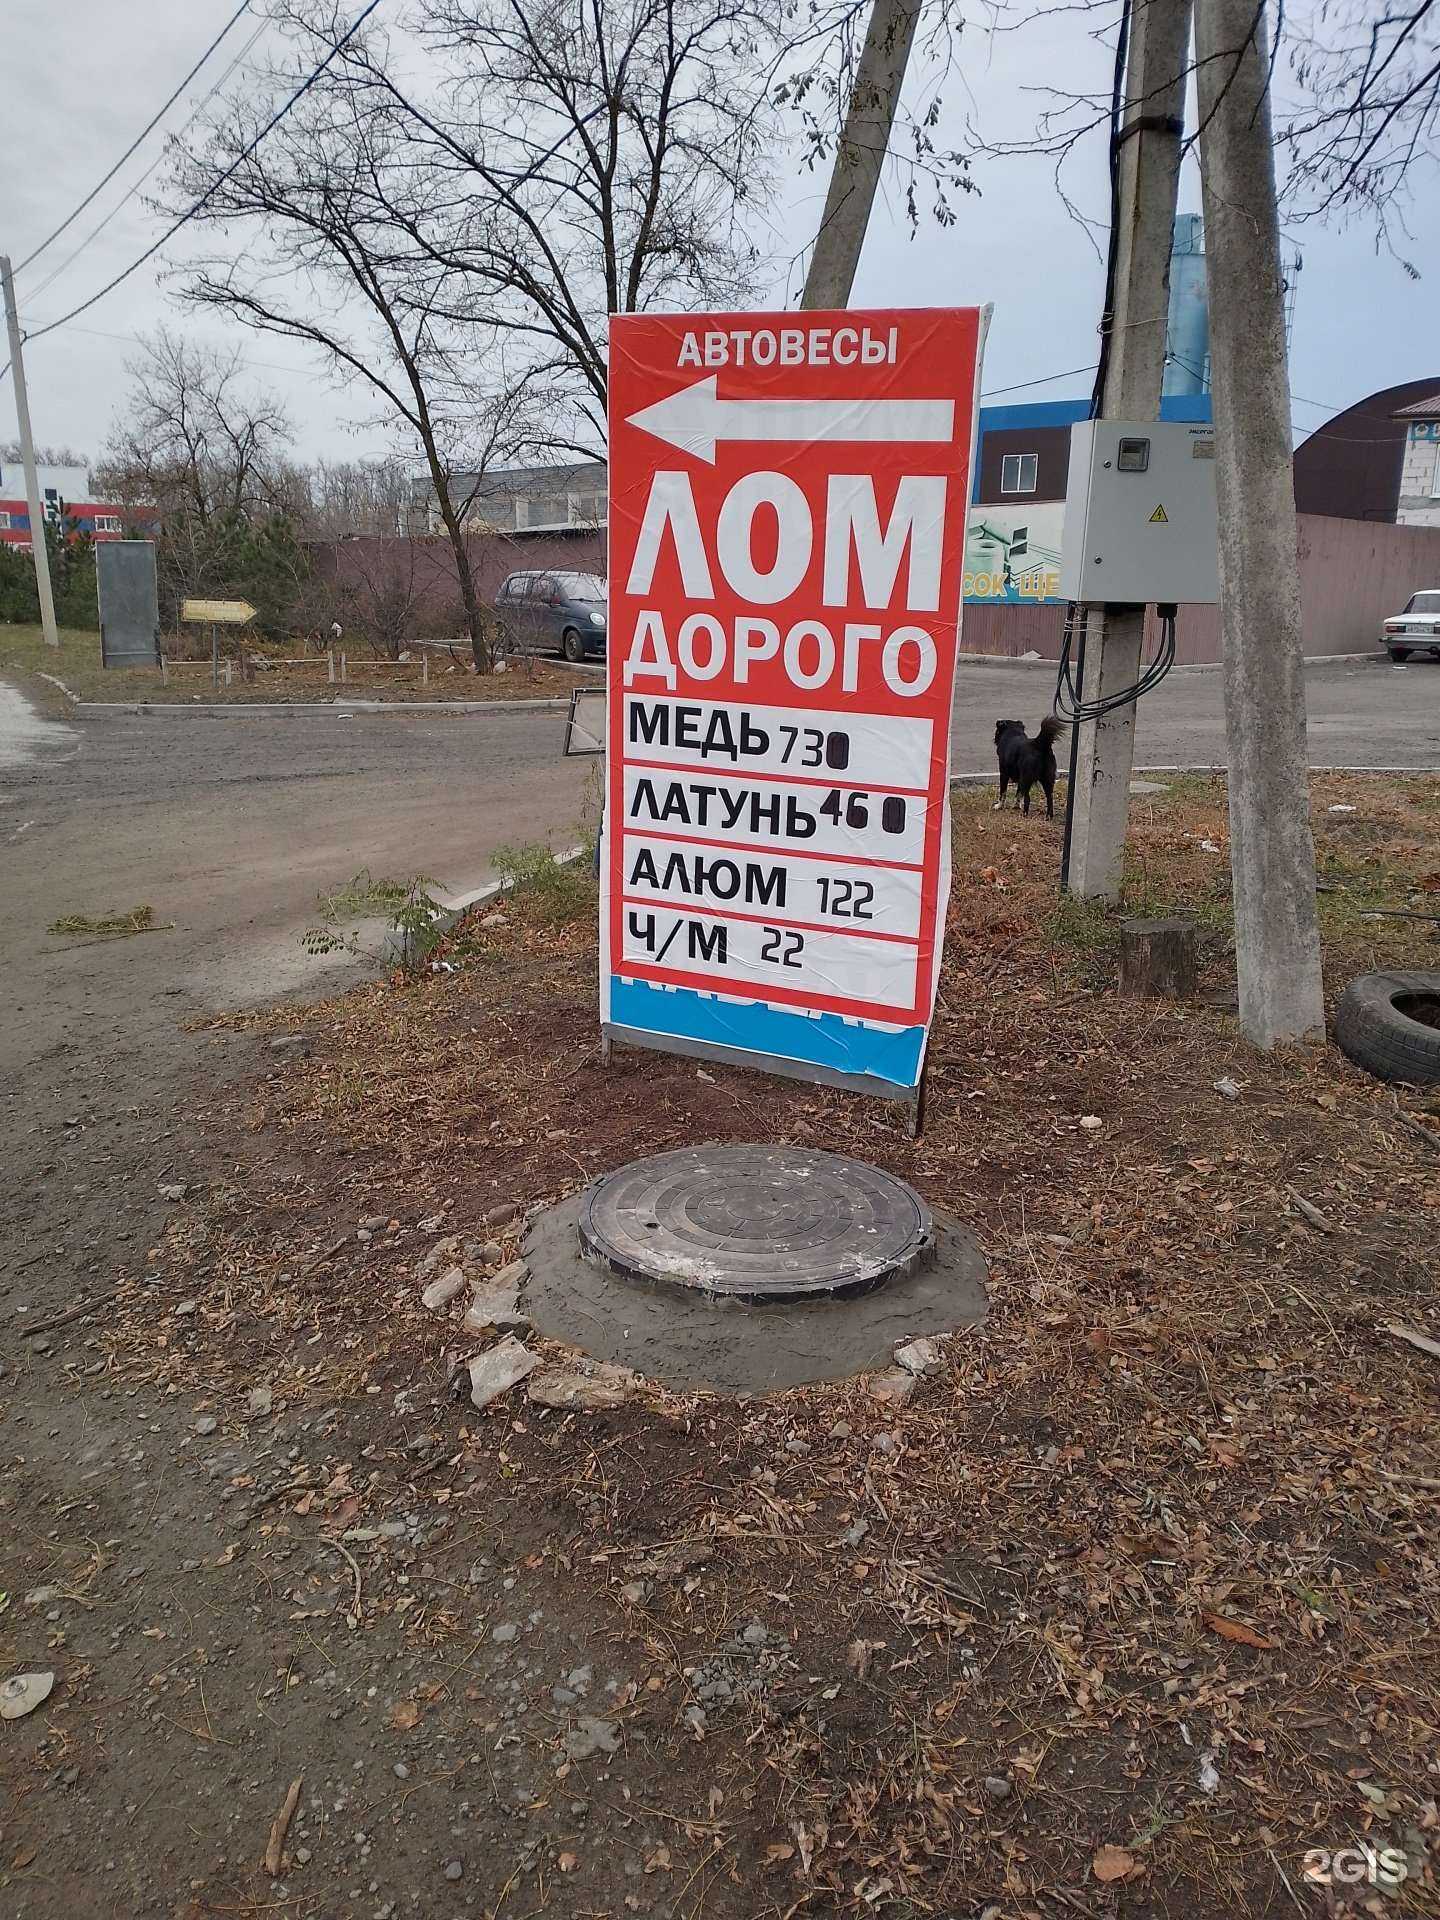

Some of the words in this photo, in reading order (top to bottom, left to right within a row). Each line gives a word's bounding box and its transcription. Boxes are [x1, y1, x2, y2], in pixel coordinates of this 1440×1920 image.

[677, 328, 898, 366] АВТОВЕСЫ
[625, 470, 948, 612] ЛОМ
[623, 610, 938, 697] ДОРОГО
[629, 702, 770, 761] МЕДЬ
[779, 725, 850, 770] 730
[630, 779, 817, 839] ЛАТУНЬ
[819, 789, 906, 834] 460
[629, 848, 788, 908] АЛЮМ
[816, 877, 875, 919] 122
[629, 911, 728, 964] Ч/М
[760, 927, 805, 968] 22
